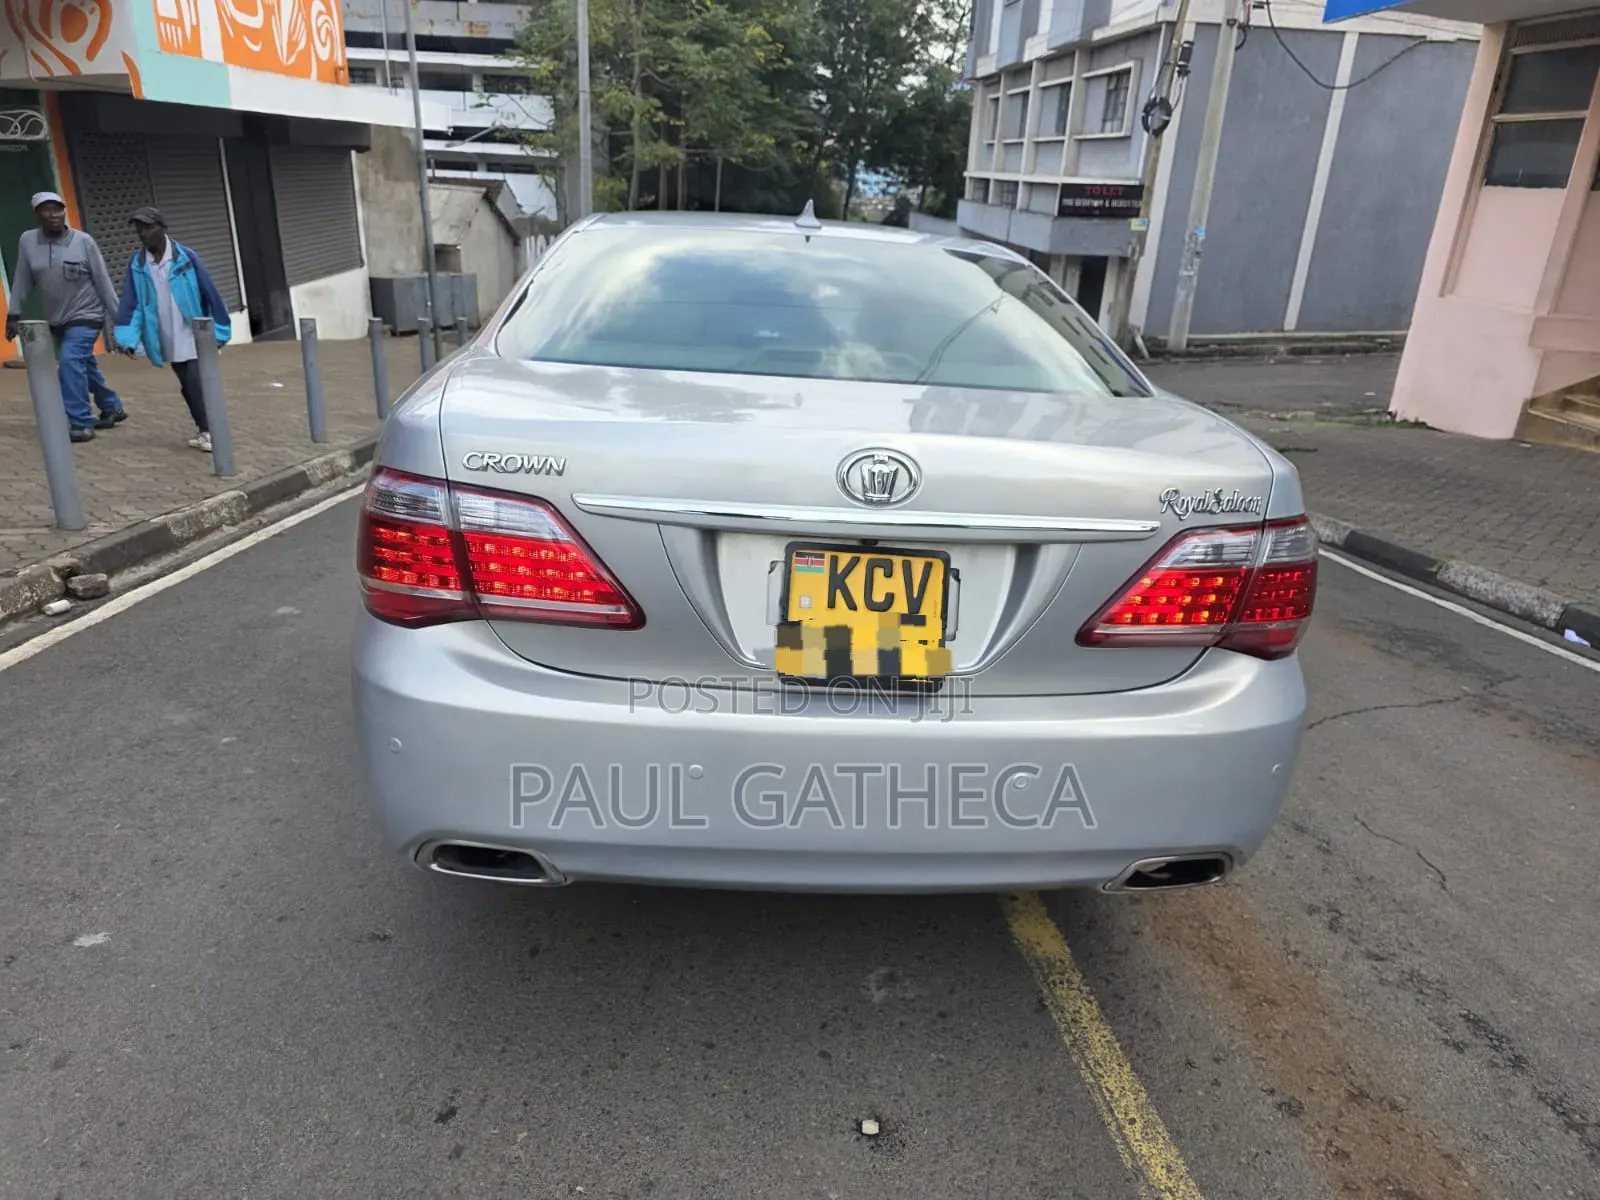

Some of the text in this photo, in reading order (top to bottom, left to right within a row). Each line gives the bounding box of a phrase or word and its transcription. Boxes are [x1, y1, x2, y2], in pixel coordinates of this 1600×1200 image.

[1085, 186, 1100, 196] TO
[462, 451, 566, 477] CROWN
[1160, 487, 1262, 520] Royal Saloon
[827, 554, 933, 615] KCV
